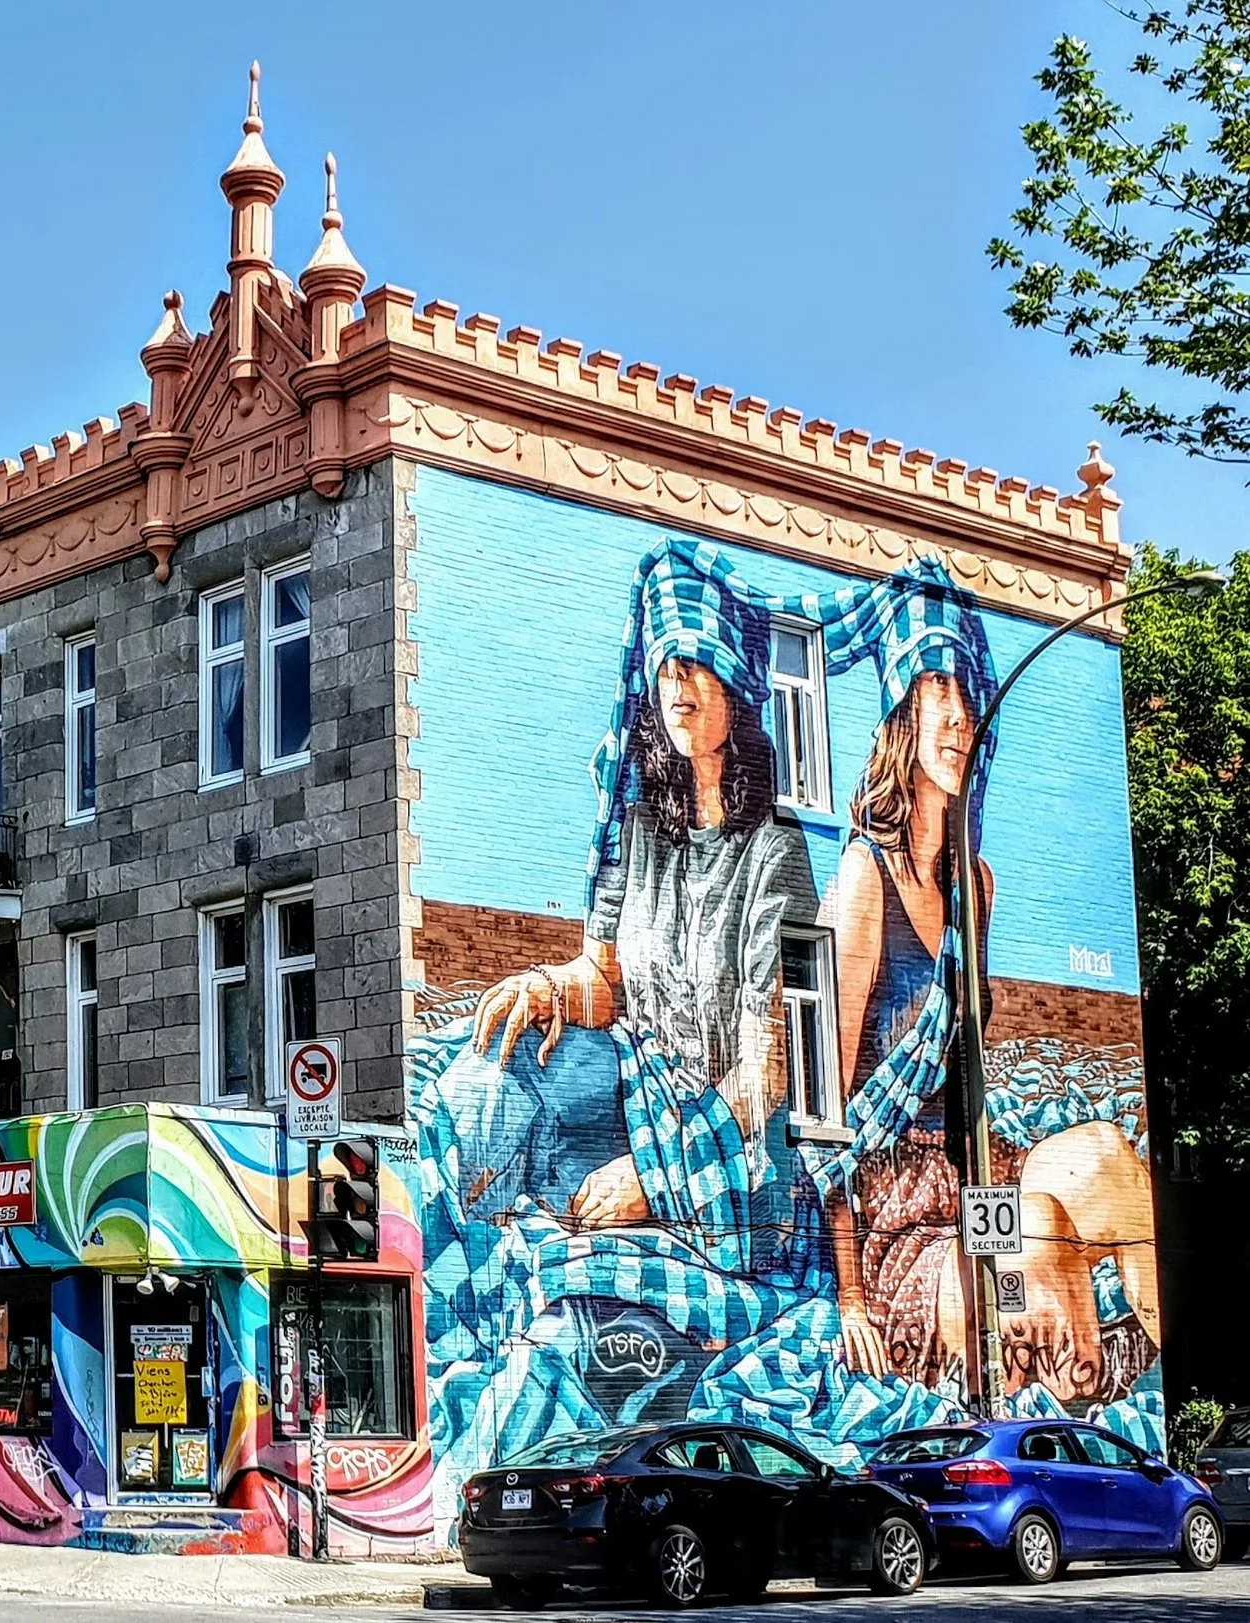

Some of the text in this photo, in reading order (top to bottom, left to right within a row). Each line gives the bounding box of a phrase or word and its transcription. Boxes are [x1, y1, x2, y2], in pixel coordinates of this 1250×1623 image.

[294, 1114, 334, 1123] LIVRAISON
[300, 1123, 329, 1132] LOCALE
[968, 1191, 1015, 1200] MAXIMUM
[971, 1202, 1015, 1236] 30
[971, 1240, 1016, 1250] SECTEUR
[597, 1332, 659, 1365] TSFC
[136, 1364, 170, 1376] Viens
